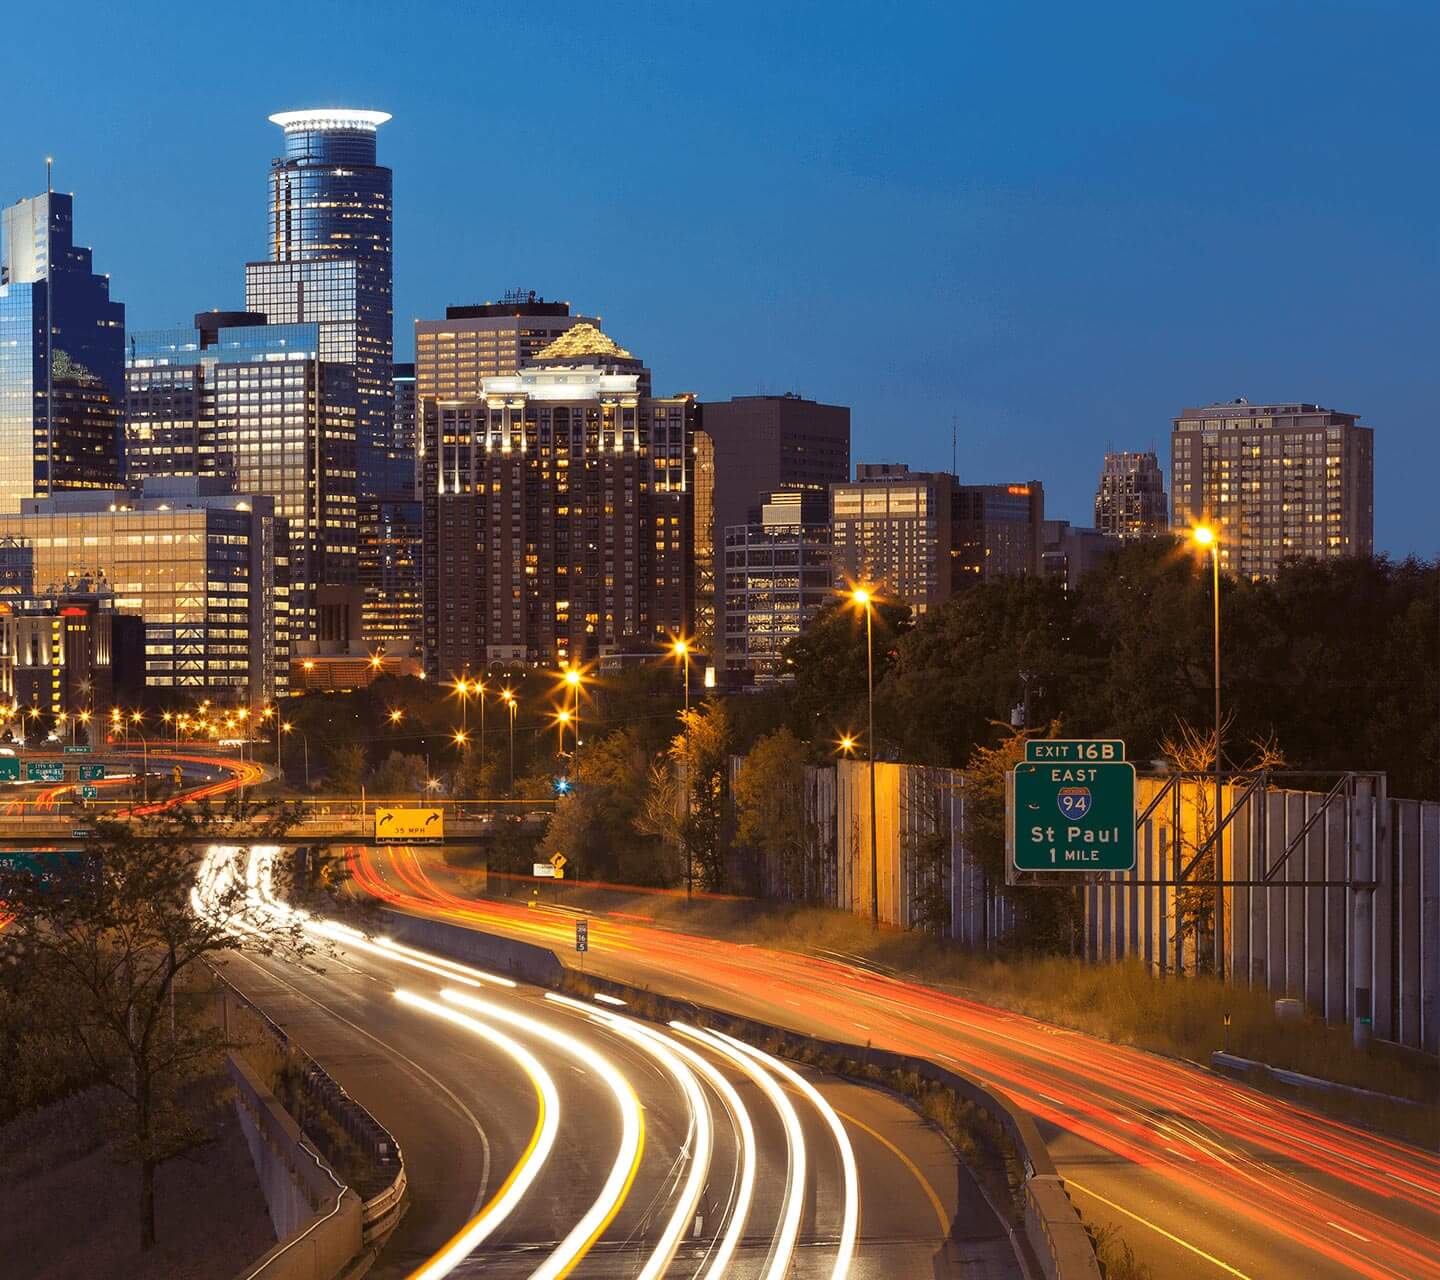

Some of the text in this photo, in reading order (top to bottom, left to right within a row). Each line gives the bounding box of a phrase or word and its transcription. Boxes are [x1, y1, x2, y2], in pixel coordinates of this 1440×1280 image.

[1035, 744, 1114, 759] EXIT 16B
[1051, 769, 1097, 782] EAST
[1062, 796, 1087, 811] 94
[1031, 827, 1118, 843] St Paul
[1049, 848, 1100, 863] 1 MILE
